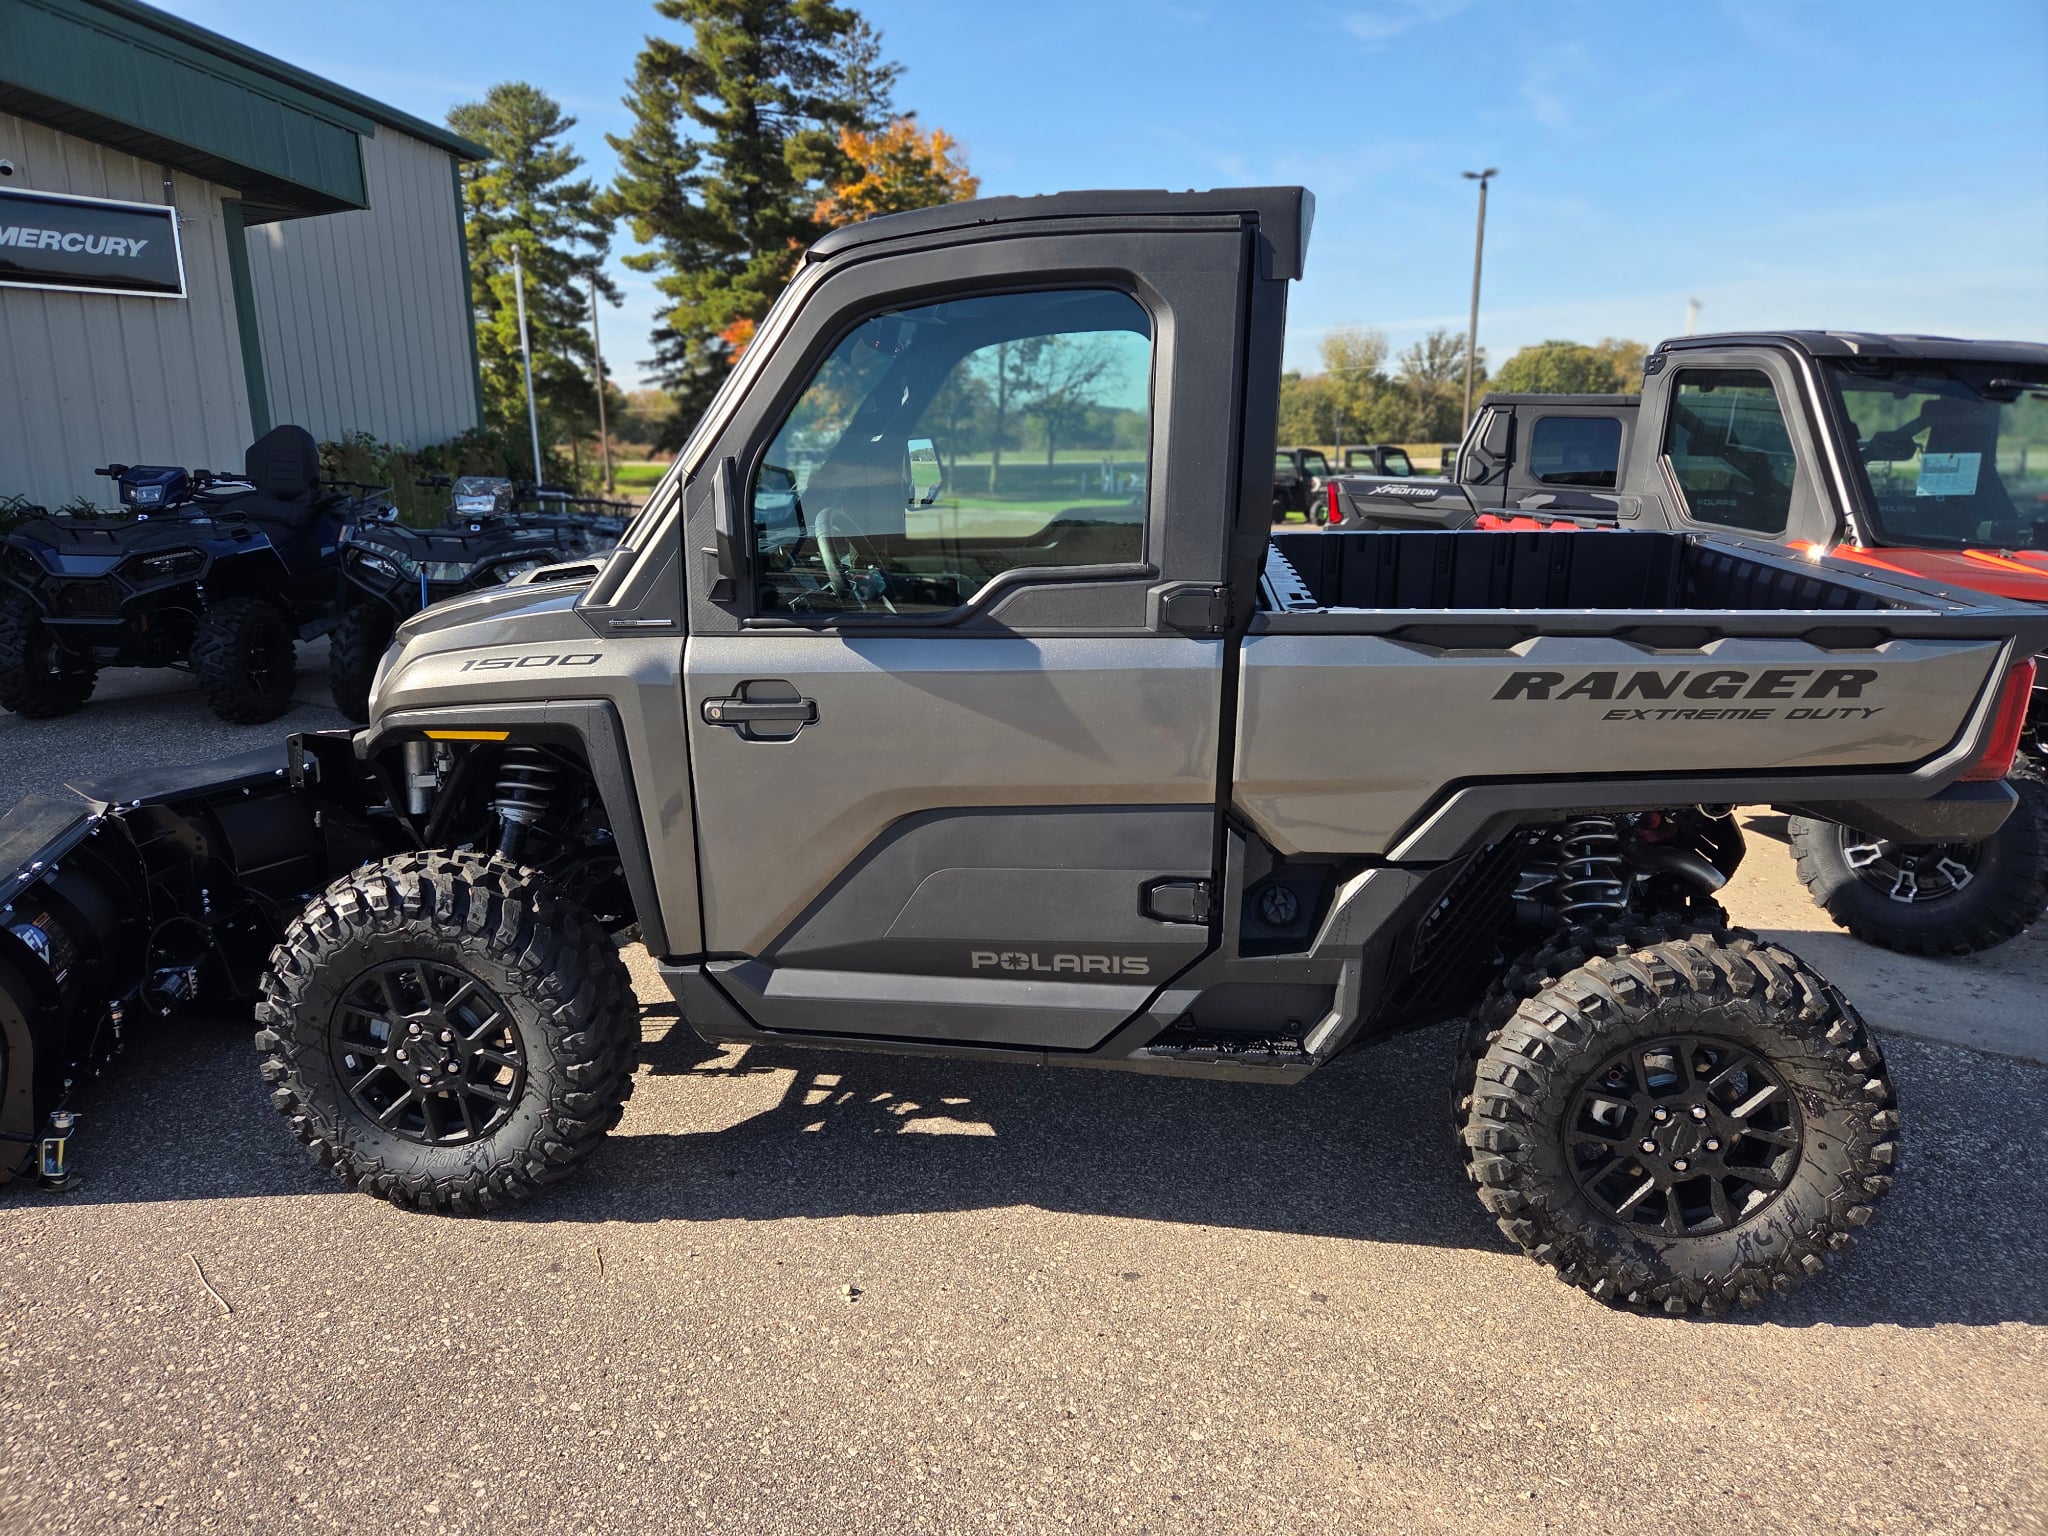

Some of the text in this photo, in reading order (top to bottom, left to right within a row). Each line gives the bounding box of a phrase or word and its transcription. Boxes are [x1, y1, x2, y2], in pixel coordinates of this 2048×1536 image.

[0, 226, 149, 257] MERCURY
[1368, 484, 1439, 496] XPEDITION
[459, 653, 603, 672] 1500
[1492, 669, 1879, 700] RANGER
[1601, 707, 1884, 720] EXTREME DUTY
[970, 951, 1150, 975] POLARIS
